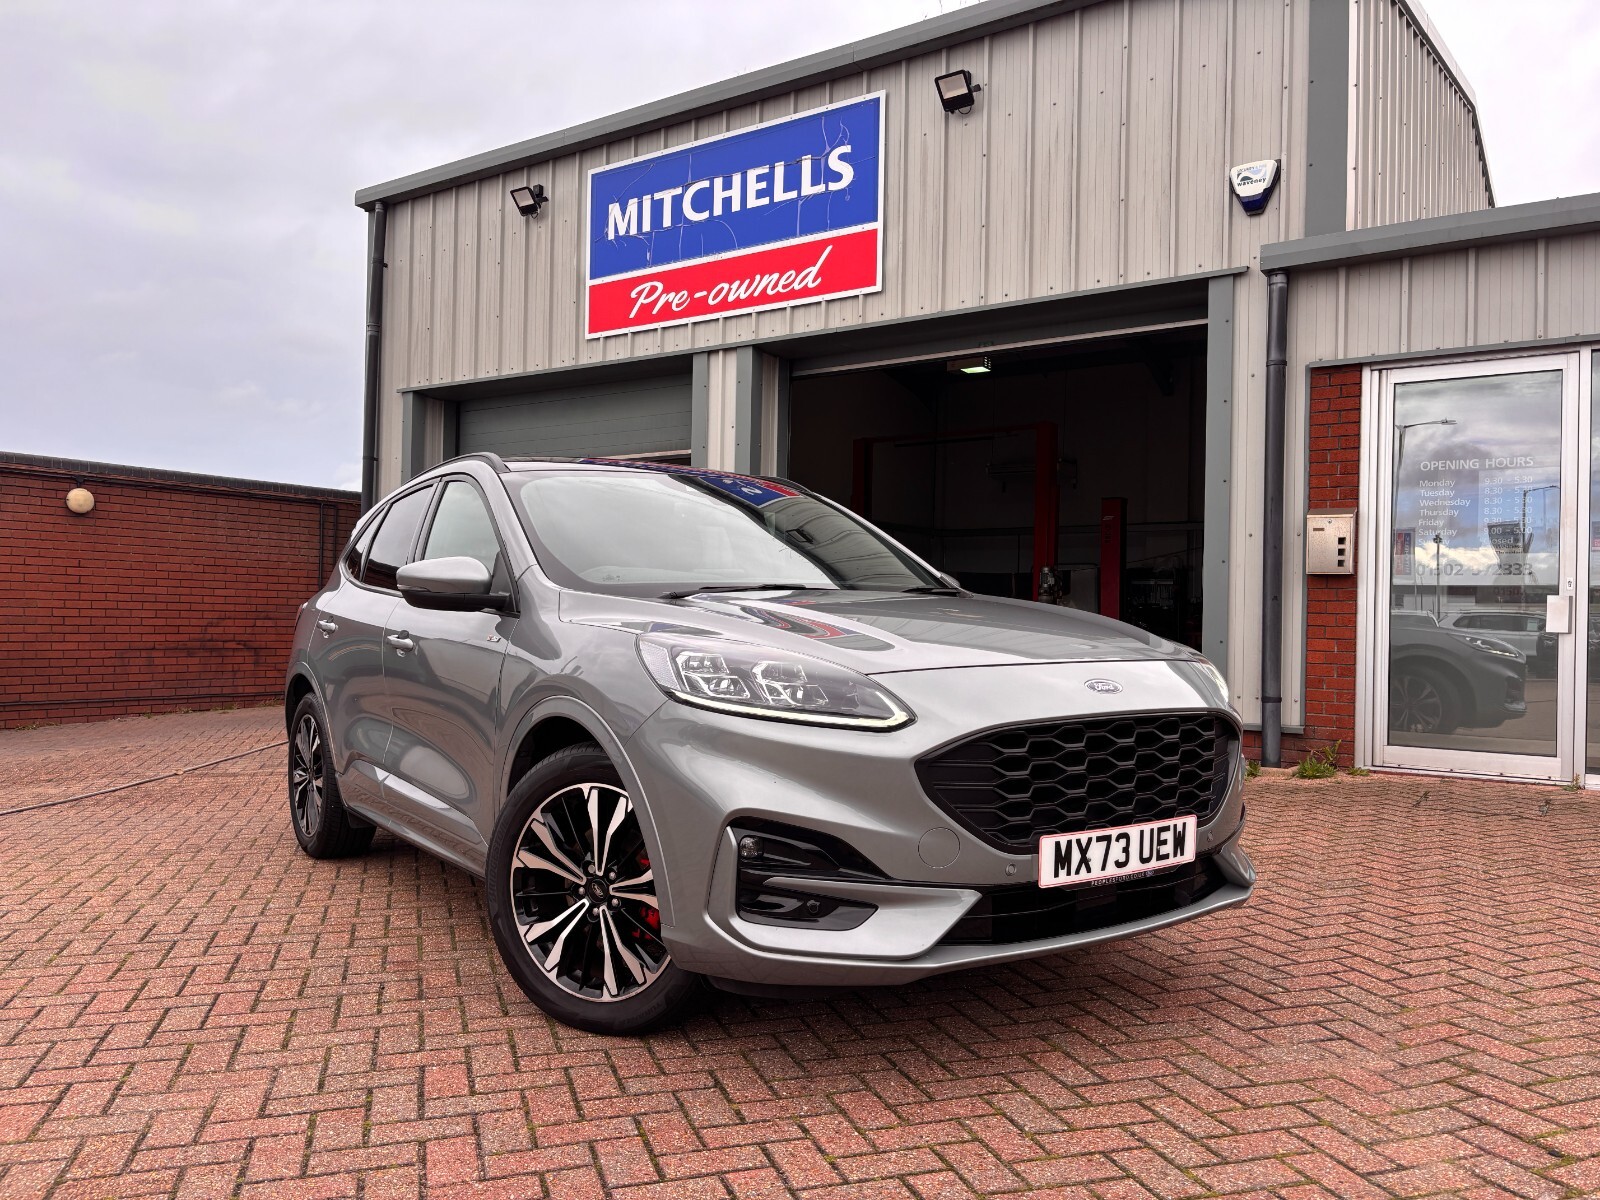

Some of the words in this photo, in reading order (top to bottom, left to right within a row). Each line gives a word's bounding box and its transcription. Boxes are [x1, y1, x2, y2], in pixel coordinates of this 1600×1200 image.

[607, 145, 855, 241] MITCHELLS
[628, 245, 833, 318] Pre-owned
[1420, 459, 1479, 471] OPENING
[1485, 456, 1534, 468] HOURS
[1419, 479, 1455, 488] Monday
[1484, 477, 1503, 485] 9.30
[1514, 476, 1533, 484] 5.30
[1420, 489, 1455, 498] Tuesday
[1484, 487, 1503, 495] 8.30
[1419, 498, 1471, 507] Wednesday
[1484, 497, 1503, 505] 8.30
[1419, 508, 1459, 517] Thursday
[1484, 507, 1503, 515] 8.30
[1418, 519, 1444, 528] Friday
[1418, 528, 1458, 537] Saturday
[1481, 536, 1514, 545] Cosed
[1053, 832, 1131, 878] MX73
[1138, 821, 1187, 865] UEW
